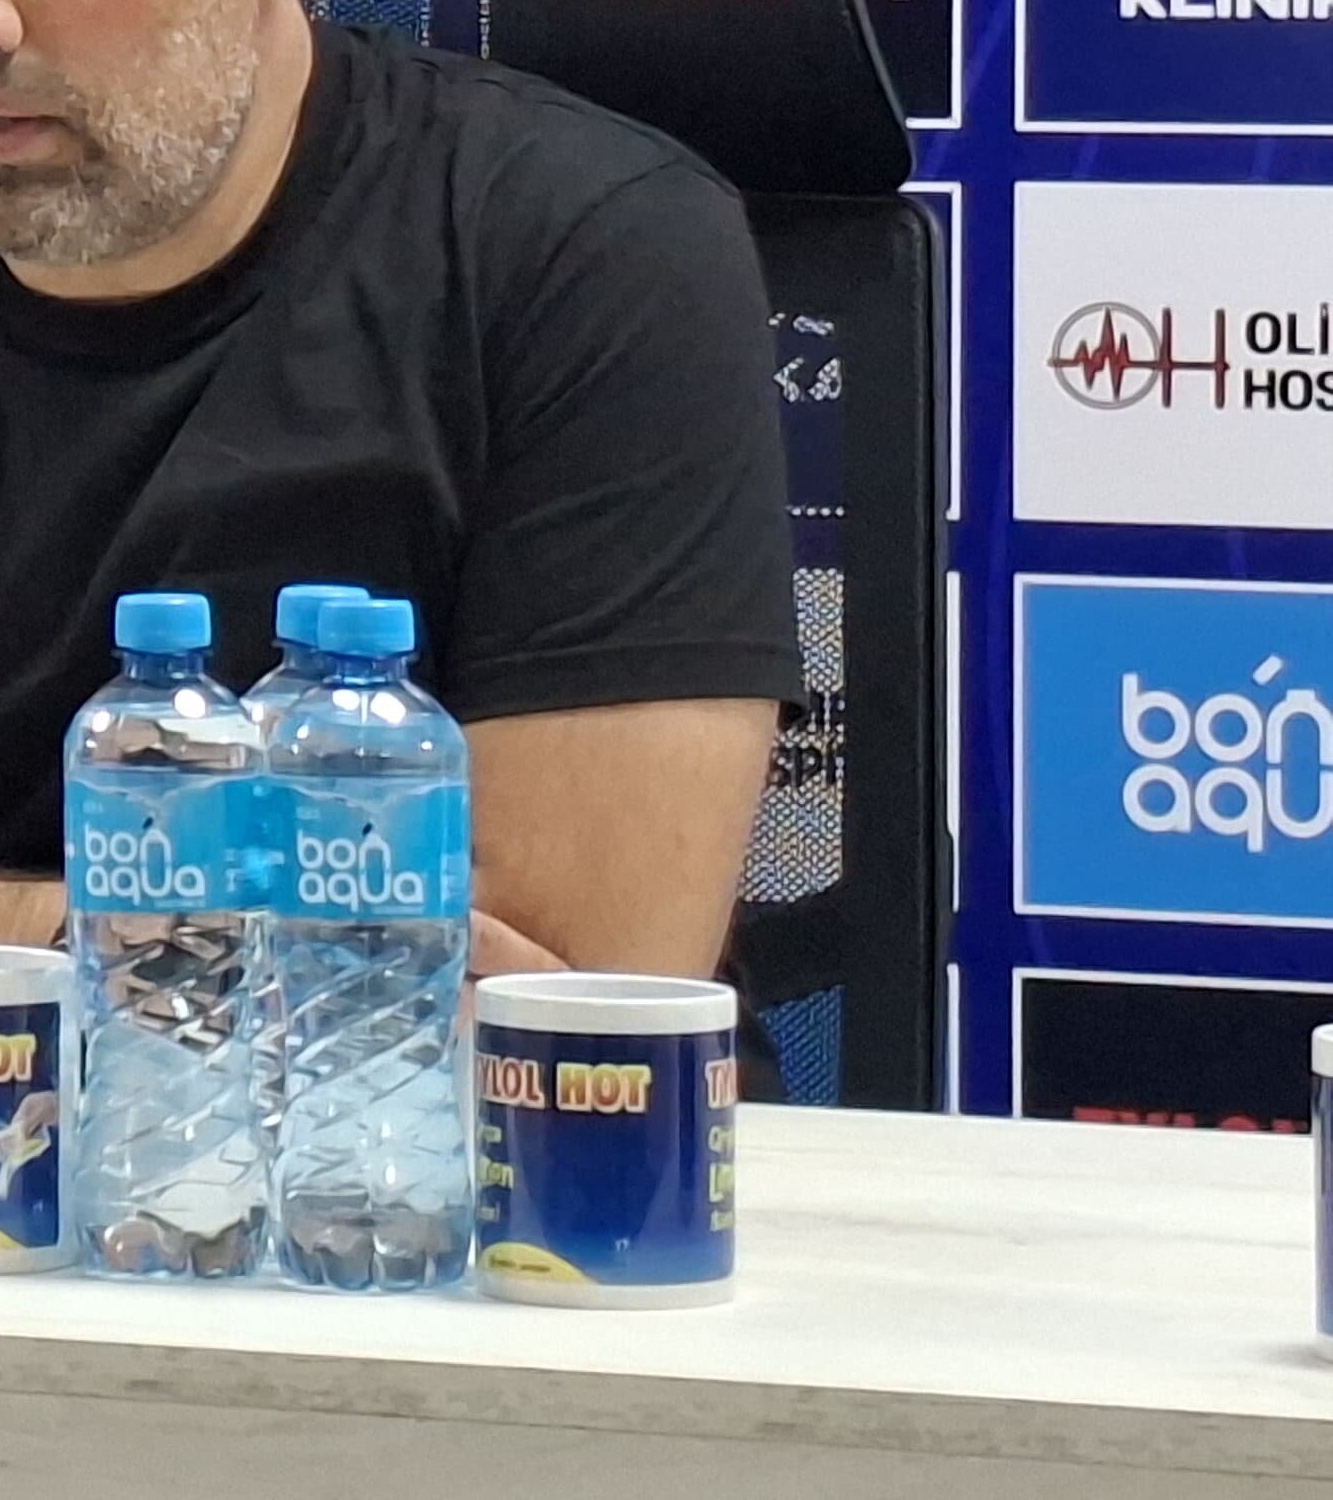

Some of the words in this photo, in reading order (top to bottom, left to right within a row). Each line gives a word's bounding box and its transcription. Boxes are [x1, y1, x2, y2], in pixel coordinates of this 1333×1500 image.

[1122, 763, 1333, 852] aqu
[85, 864, 206, 906] aqua
[298, 871, 424, 912] aqua
[556, 1062, 652, 1114] HOT
